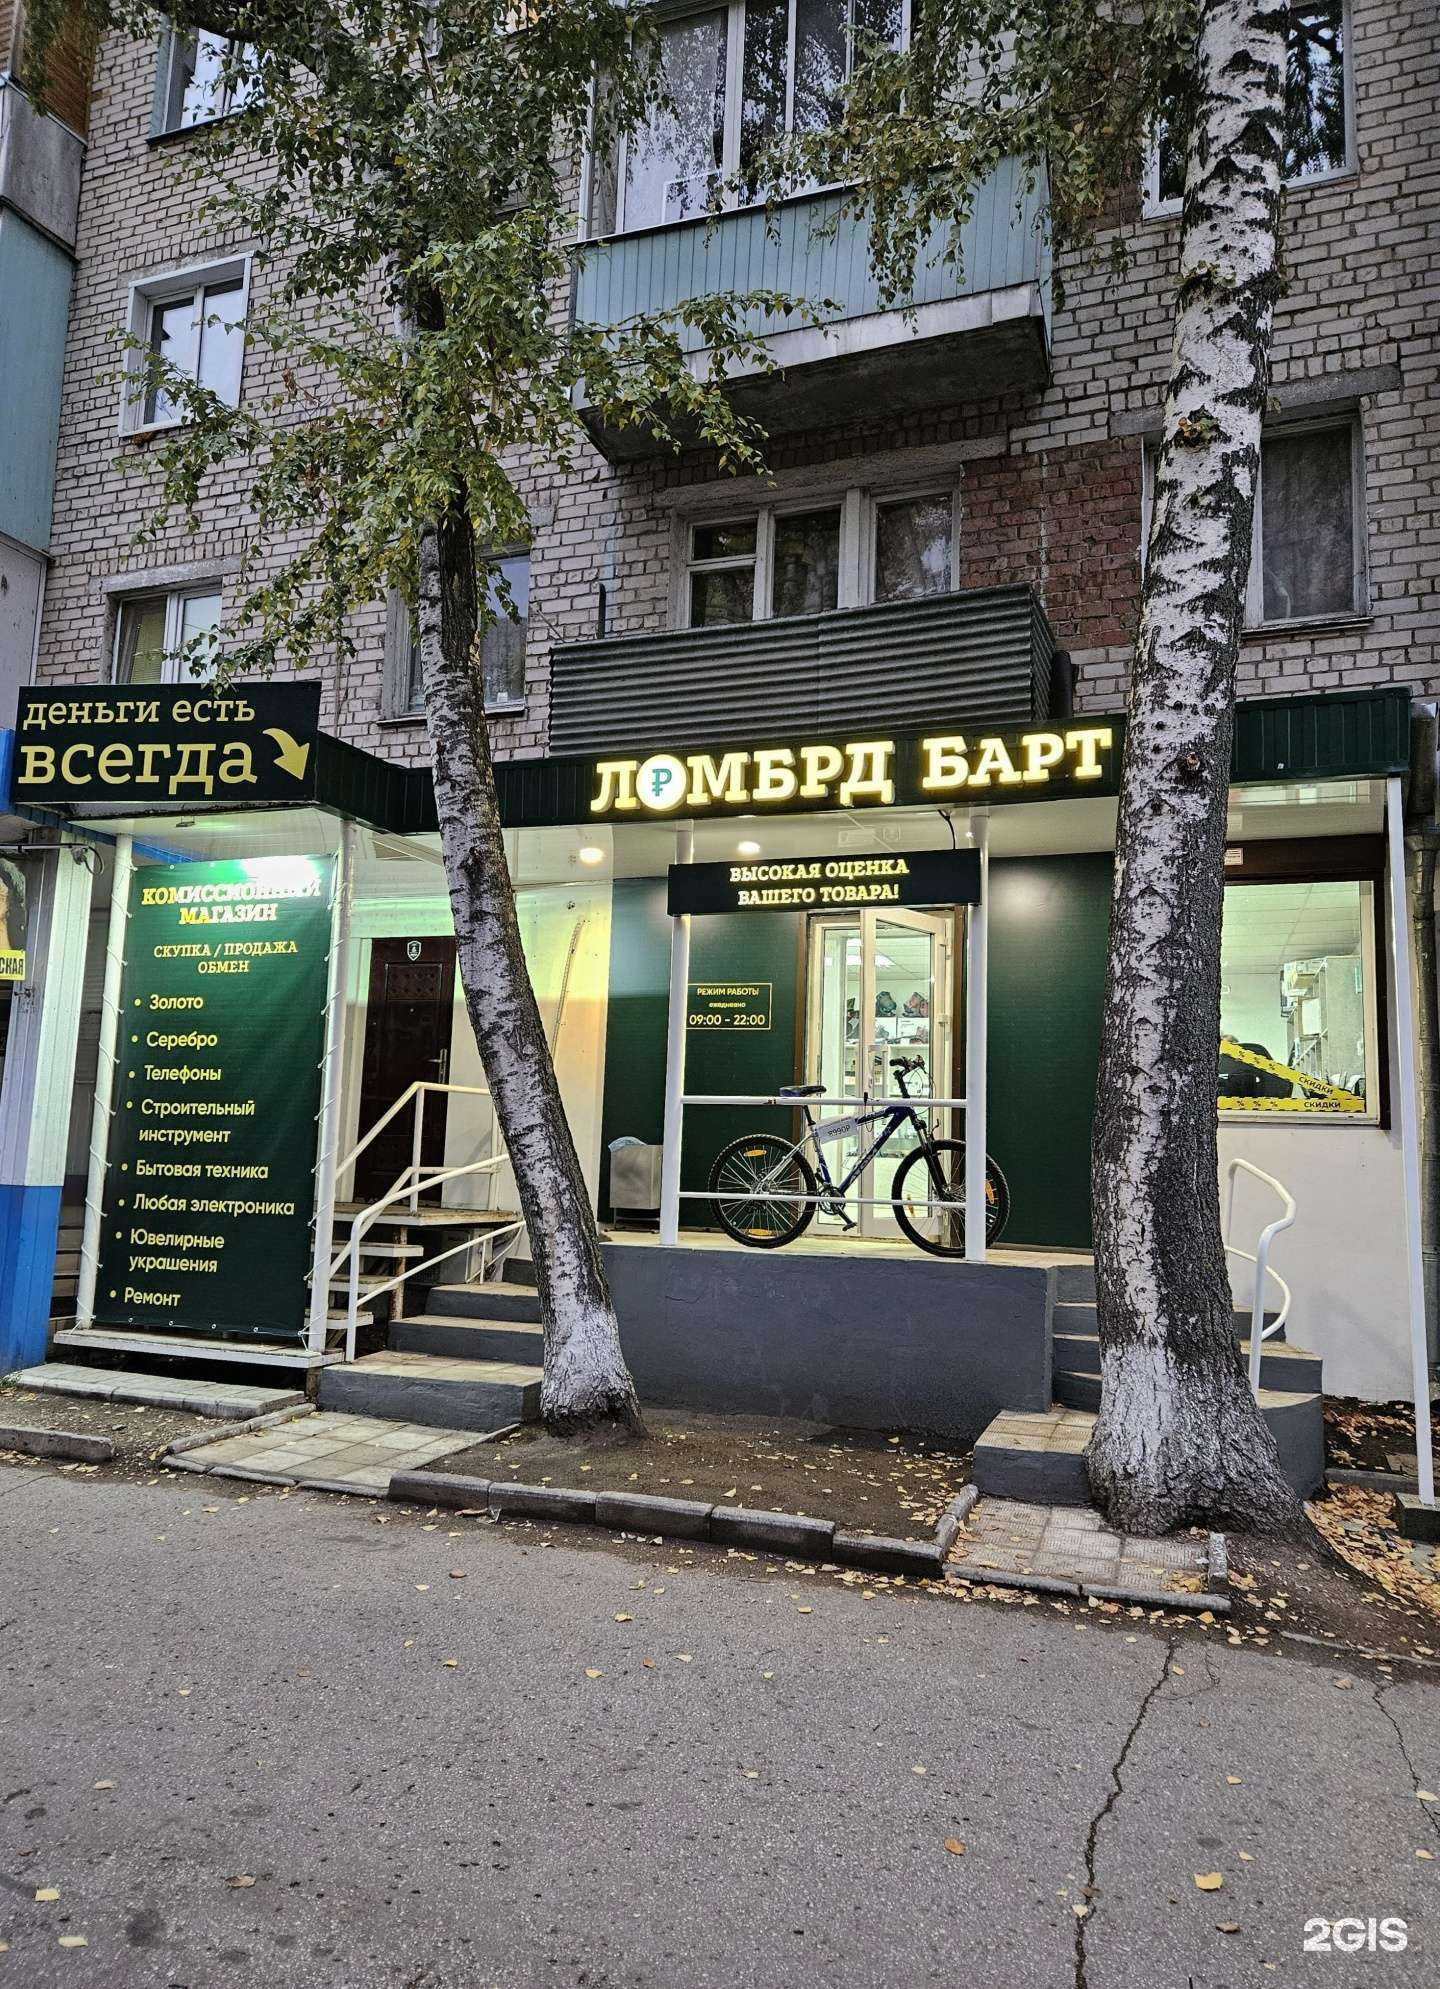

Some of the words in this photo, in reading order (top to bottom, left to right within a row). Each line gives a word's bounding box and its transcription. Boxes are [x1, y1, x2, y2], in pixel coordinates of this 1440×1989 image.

[23, 701, 160, 730] деньги
[172, 699, 255, 722] есть
[18, 741, 257, 795] всегда
[921, 728, 1112, 791] БАРТ
[729, 863, 821, 882] ВЫСОКАЯ
[825, 858, 910, 880] ОЦЕНКА
[737, 887, 816, 905] ВАШЕГО
[820, 884, 899, 902] ТОВАРА!
[179, 903, 278, 925] МАГАЗИН
[154, 944, 211, 958] СКУПКА
[224, 941, 298, 956] ПРОДАЖА
[198, 960, 249, 974] ОБМЕН
[697, 987, 725, 996] РЕЖИМ
[727, 987, 759, 996] РАБОТЫ
[150, 995, 203, 1010] Золото
[689, 1014, 721, 1025] 09:00
[733, 1014, 765, 1025] 22:00
[146, 1032, 218, 1050] Серебро
[144, 1065, 221, 1083] Телефоны
[1298, 1076, 1333, 1095] СКИДКИ
[141, 1099, 255, 1118] Строительный
[1303, 1101, 1340, 1109] СКИДКИ
[139, 1128, 231, 1145] инструмент
[136, 1159, 201, 1177] Бытовая
[205, 1164, 268, 1179] техника
[133, 1194, 186, 1211] Любая
[190, 1198, 294, 1216] электроника
[130, 1228, 225, 1249] Ювелирные
[129, 1254, 217, 1273] украшения
[124, 1287, 181, 1307] Ремонт
